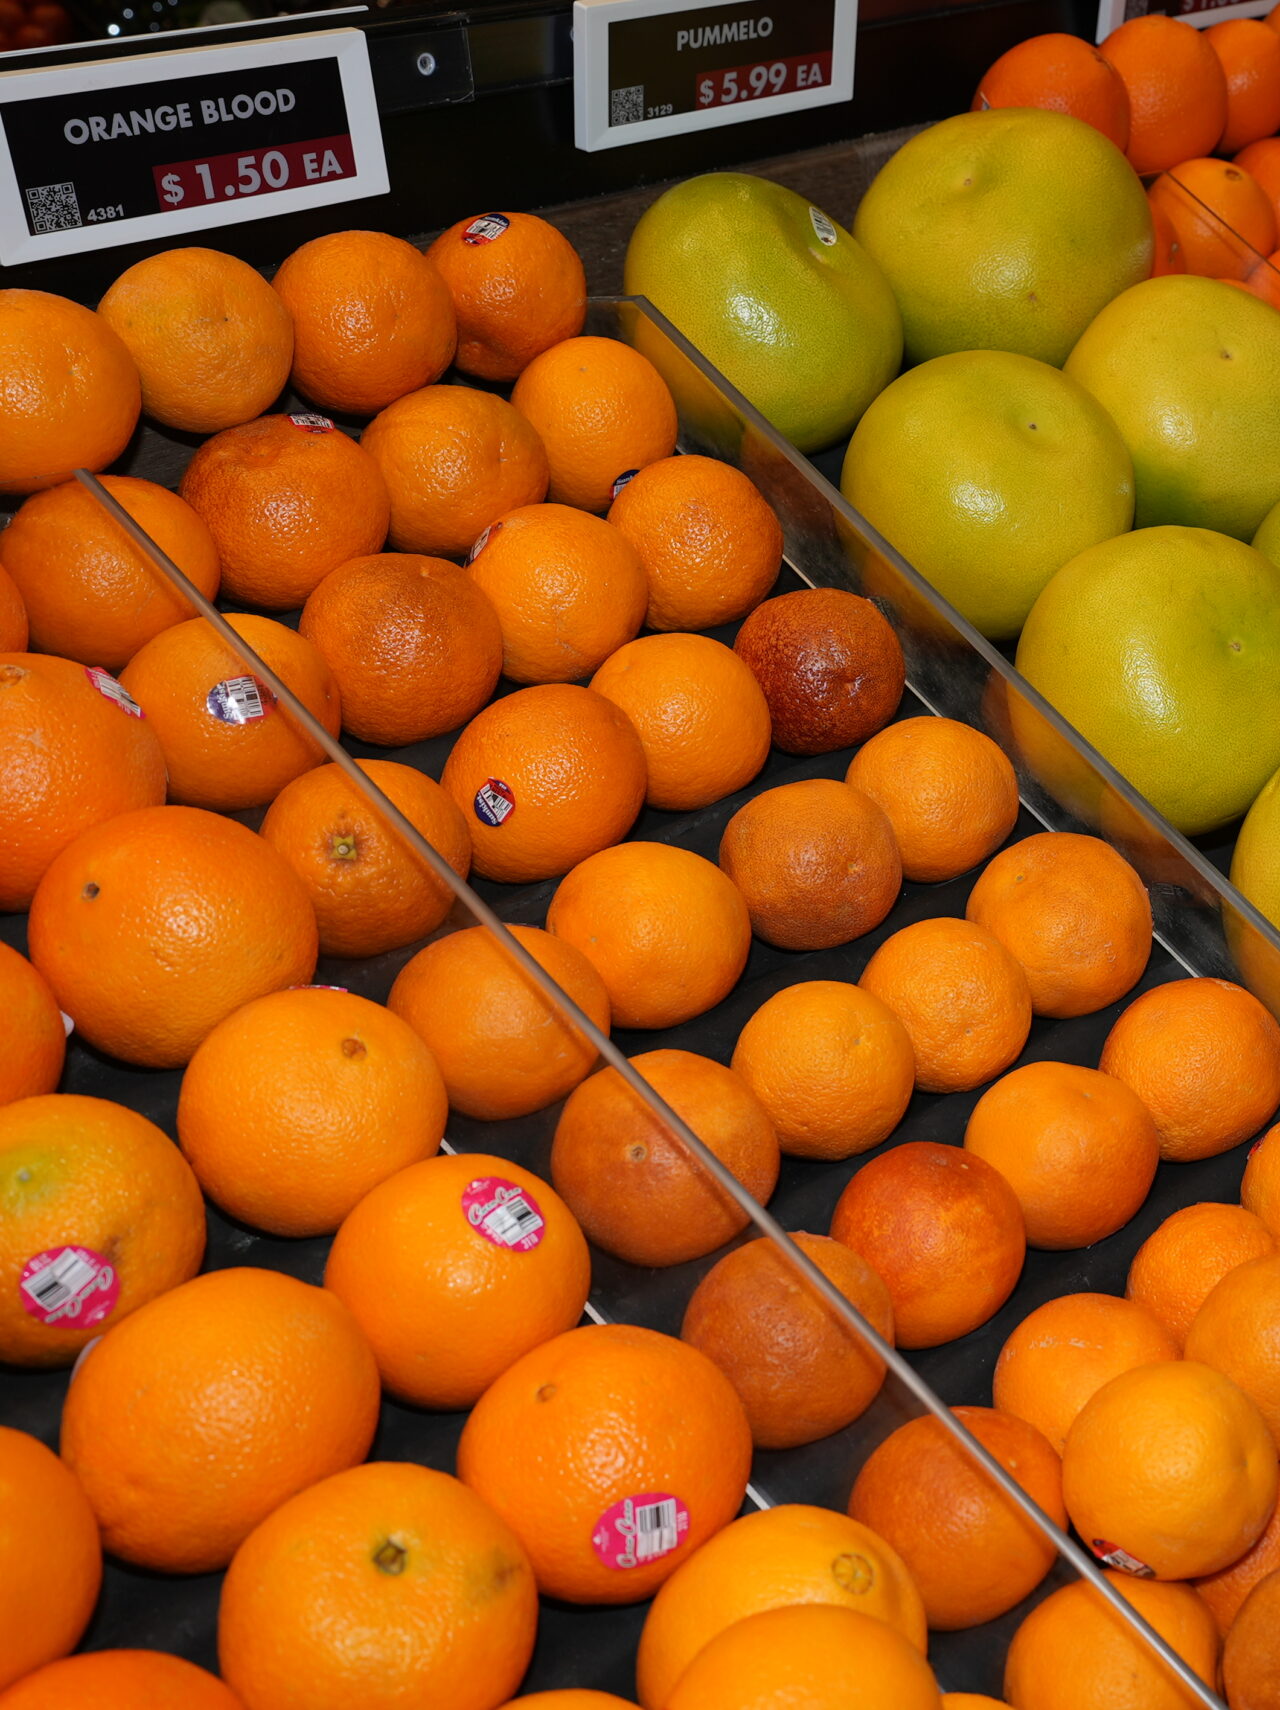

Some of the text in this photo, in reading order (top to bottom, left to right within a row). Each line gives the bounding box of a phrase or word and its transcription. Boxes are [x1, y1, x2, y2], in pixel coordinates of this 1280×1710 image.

[676, 16, 774, 52] PUMMELO
[796, 62, 823, 88] EA
[64, 88, 296, 145] ORANGE BLOOD
[646, 104, 674, 118] 3129
[302, 149, 344, 180] EA
[87, 203, 125, 222] 4381
[475, 792, 498, 825] Sunkist
